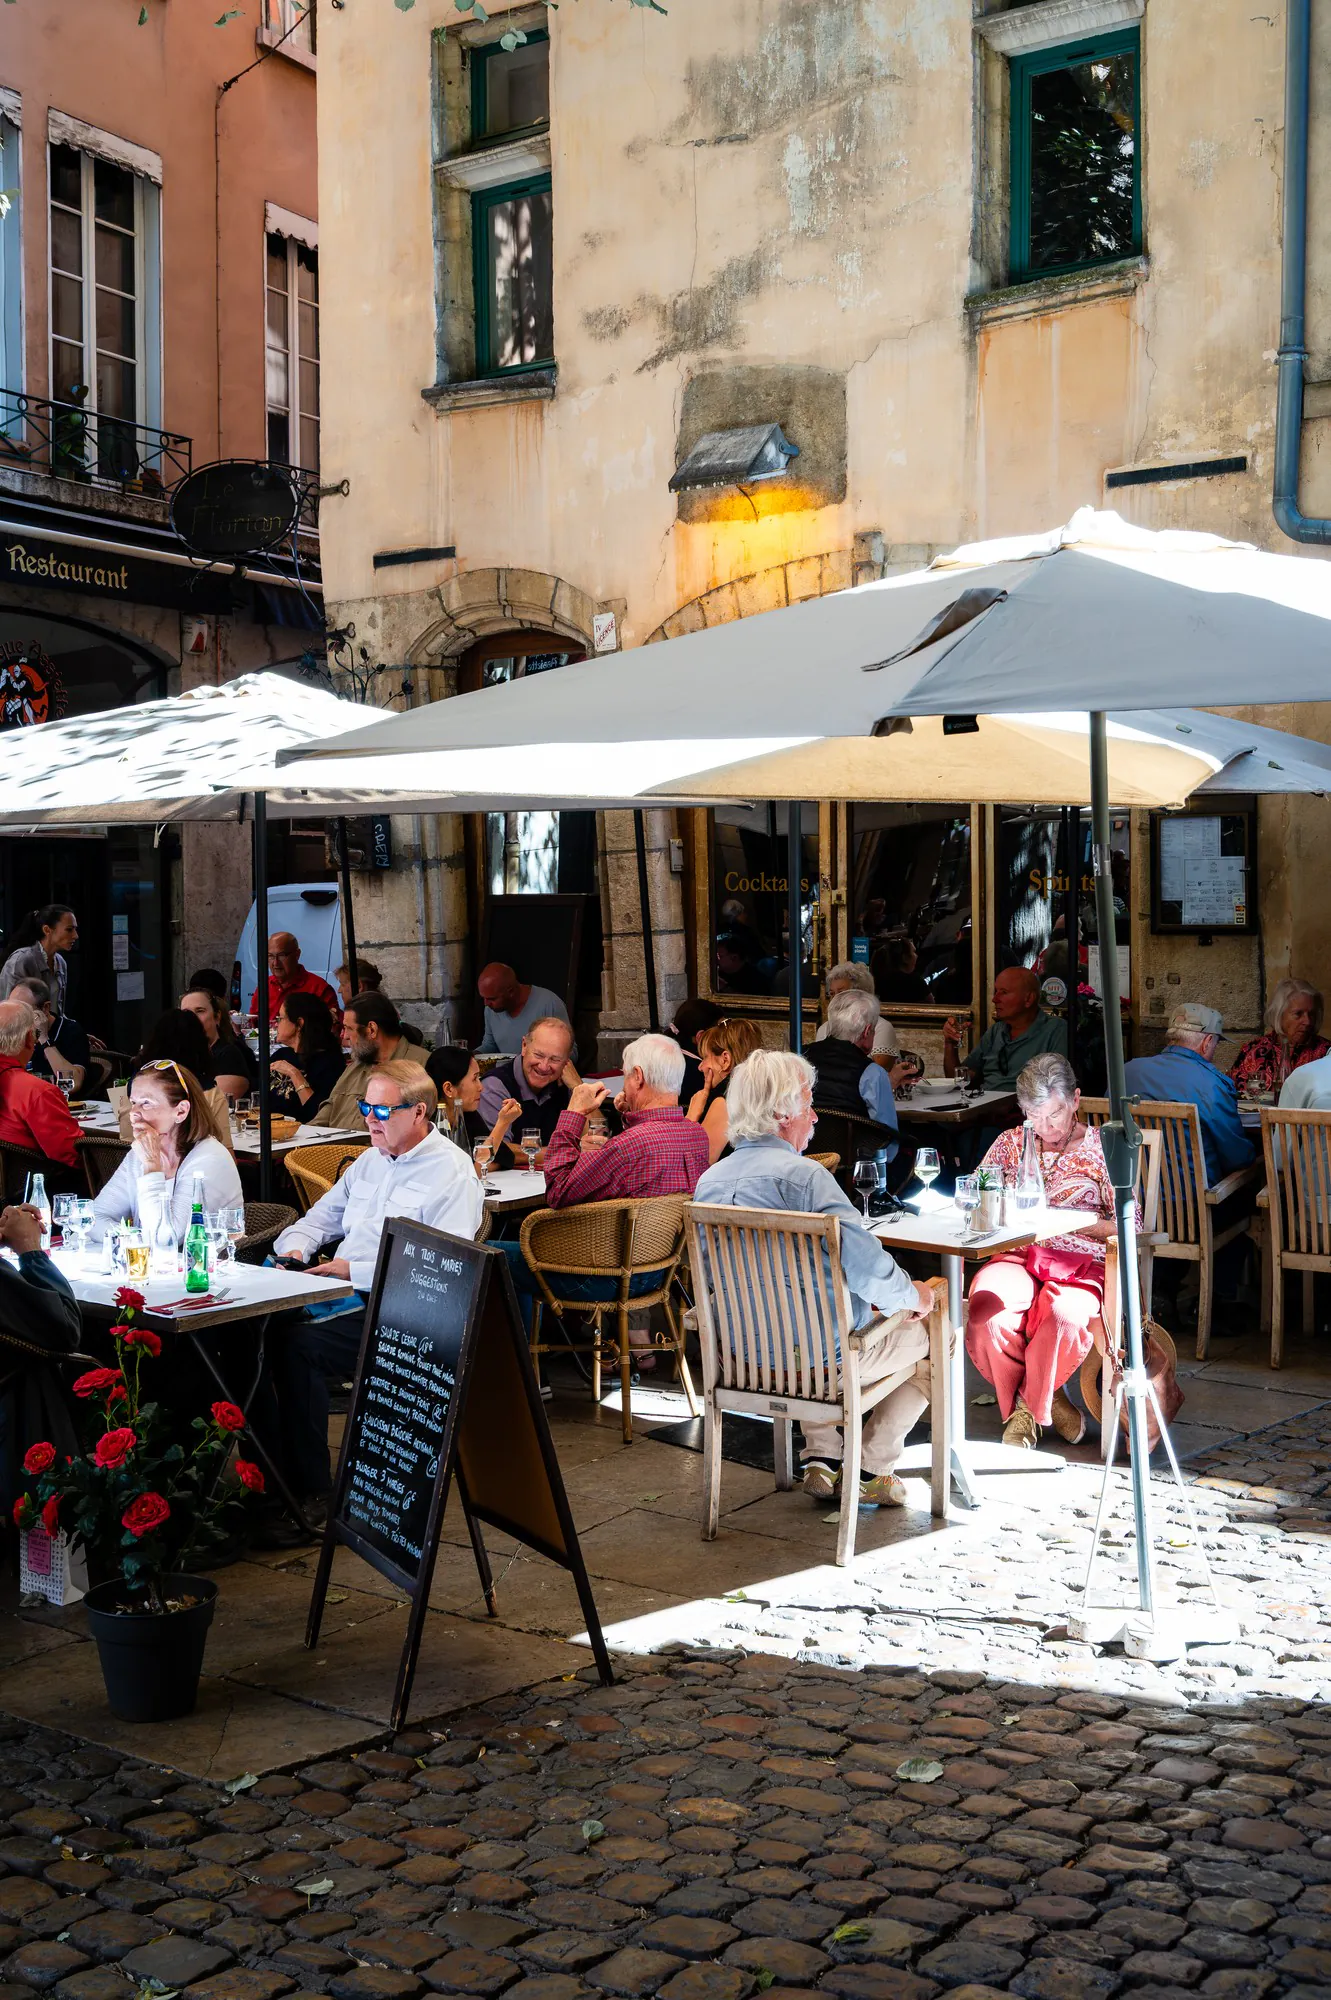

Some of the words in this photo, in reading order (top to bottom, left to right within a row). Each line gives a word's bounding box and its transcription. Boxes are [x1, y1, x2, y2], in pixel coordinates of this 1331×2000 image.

[4, 544, 128, 590] Restaurant
[596, 619, 616, 647] LICENCE
[724, 872, 810, 892] Cocktas
[1029, 868, 1096, 899] Spirts
[403, 1241, 416, 1258] AUX
[421, 1248, 436, 1264] TROIS
[440, 1257, 463, 1276] MARIES
[410, 1268, 448, 1293] SUGGESTIONS
[380, 1326, 400, 1342] SALADE
[401, 1330, 417, 1348] CÉSAR
[378, 1341, 396, 1356] SALADE
[417, 1357, 432, 1371] POULET
[370, 1376, 392, 1391] TARTARE
[391, 1384, 397, 1394] DE
[398, 1388, 416, 1403] SAUMON
[417, 1396, 430, 1412] FRAIS
[395, 1365, 411, 1378] TOMATES
[429, 1380, 451, 1400] PARMESAN
[376, 1393, 393, 1408] POMMES
[412, 1408, 426, 1425] FRITES
[361, 1425, 379, 1442] POMMES
[385, 1440, 396, 1452] TERRE
[363, 1412, 390, 1434] SAUCISSON
[390, 1424, 413, 1444] BRIOCHÉ
[360, 1438, 366, 1448] ET
[368, 1442, 381, 1455] SAUCE
[398, 1458, 414, 1474] ROUGE
[353, 1475, 364, 1489] PAIN
[382, 1492, 400, 1508] MAISON
[355, 1460, 378, 1480] BURGER
[380, 1470, 387, 1482] 3
[386, 1476, 405, 1495] MARIES
[382, 1507, 400, 1526] TOMATES
[391, 1528, 407, 1548] FRITES
